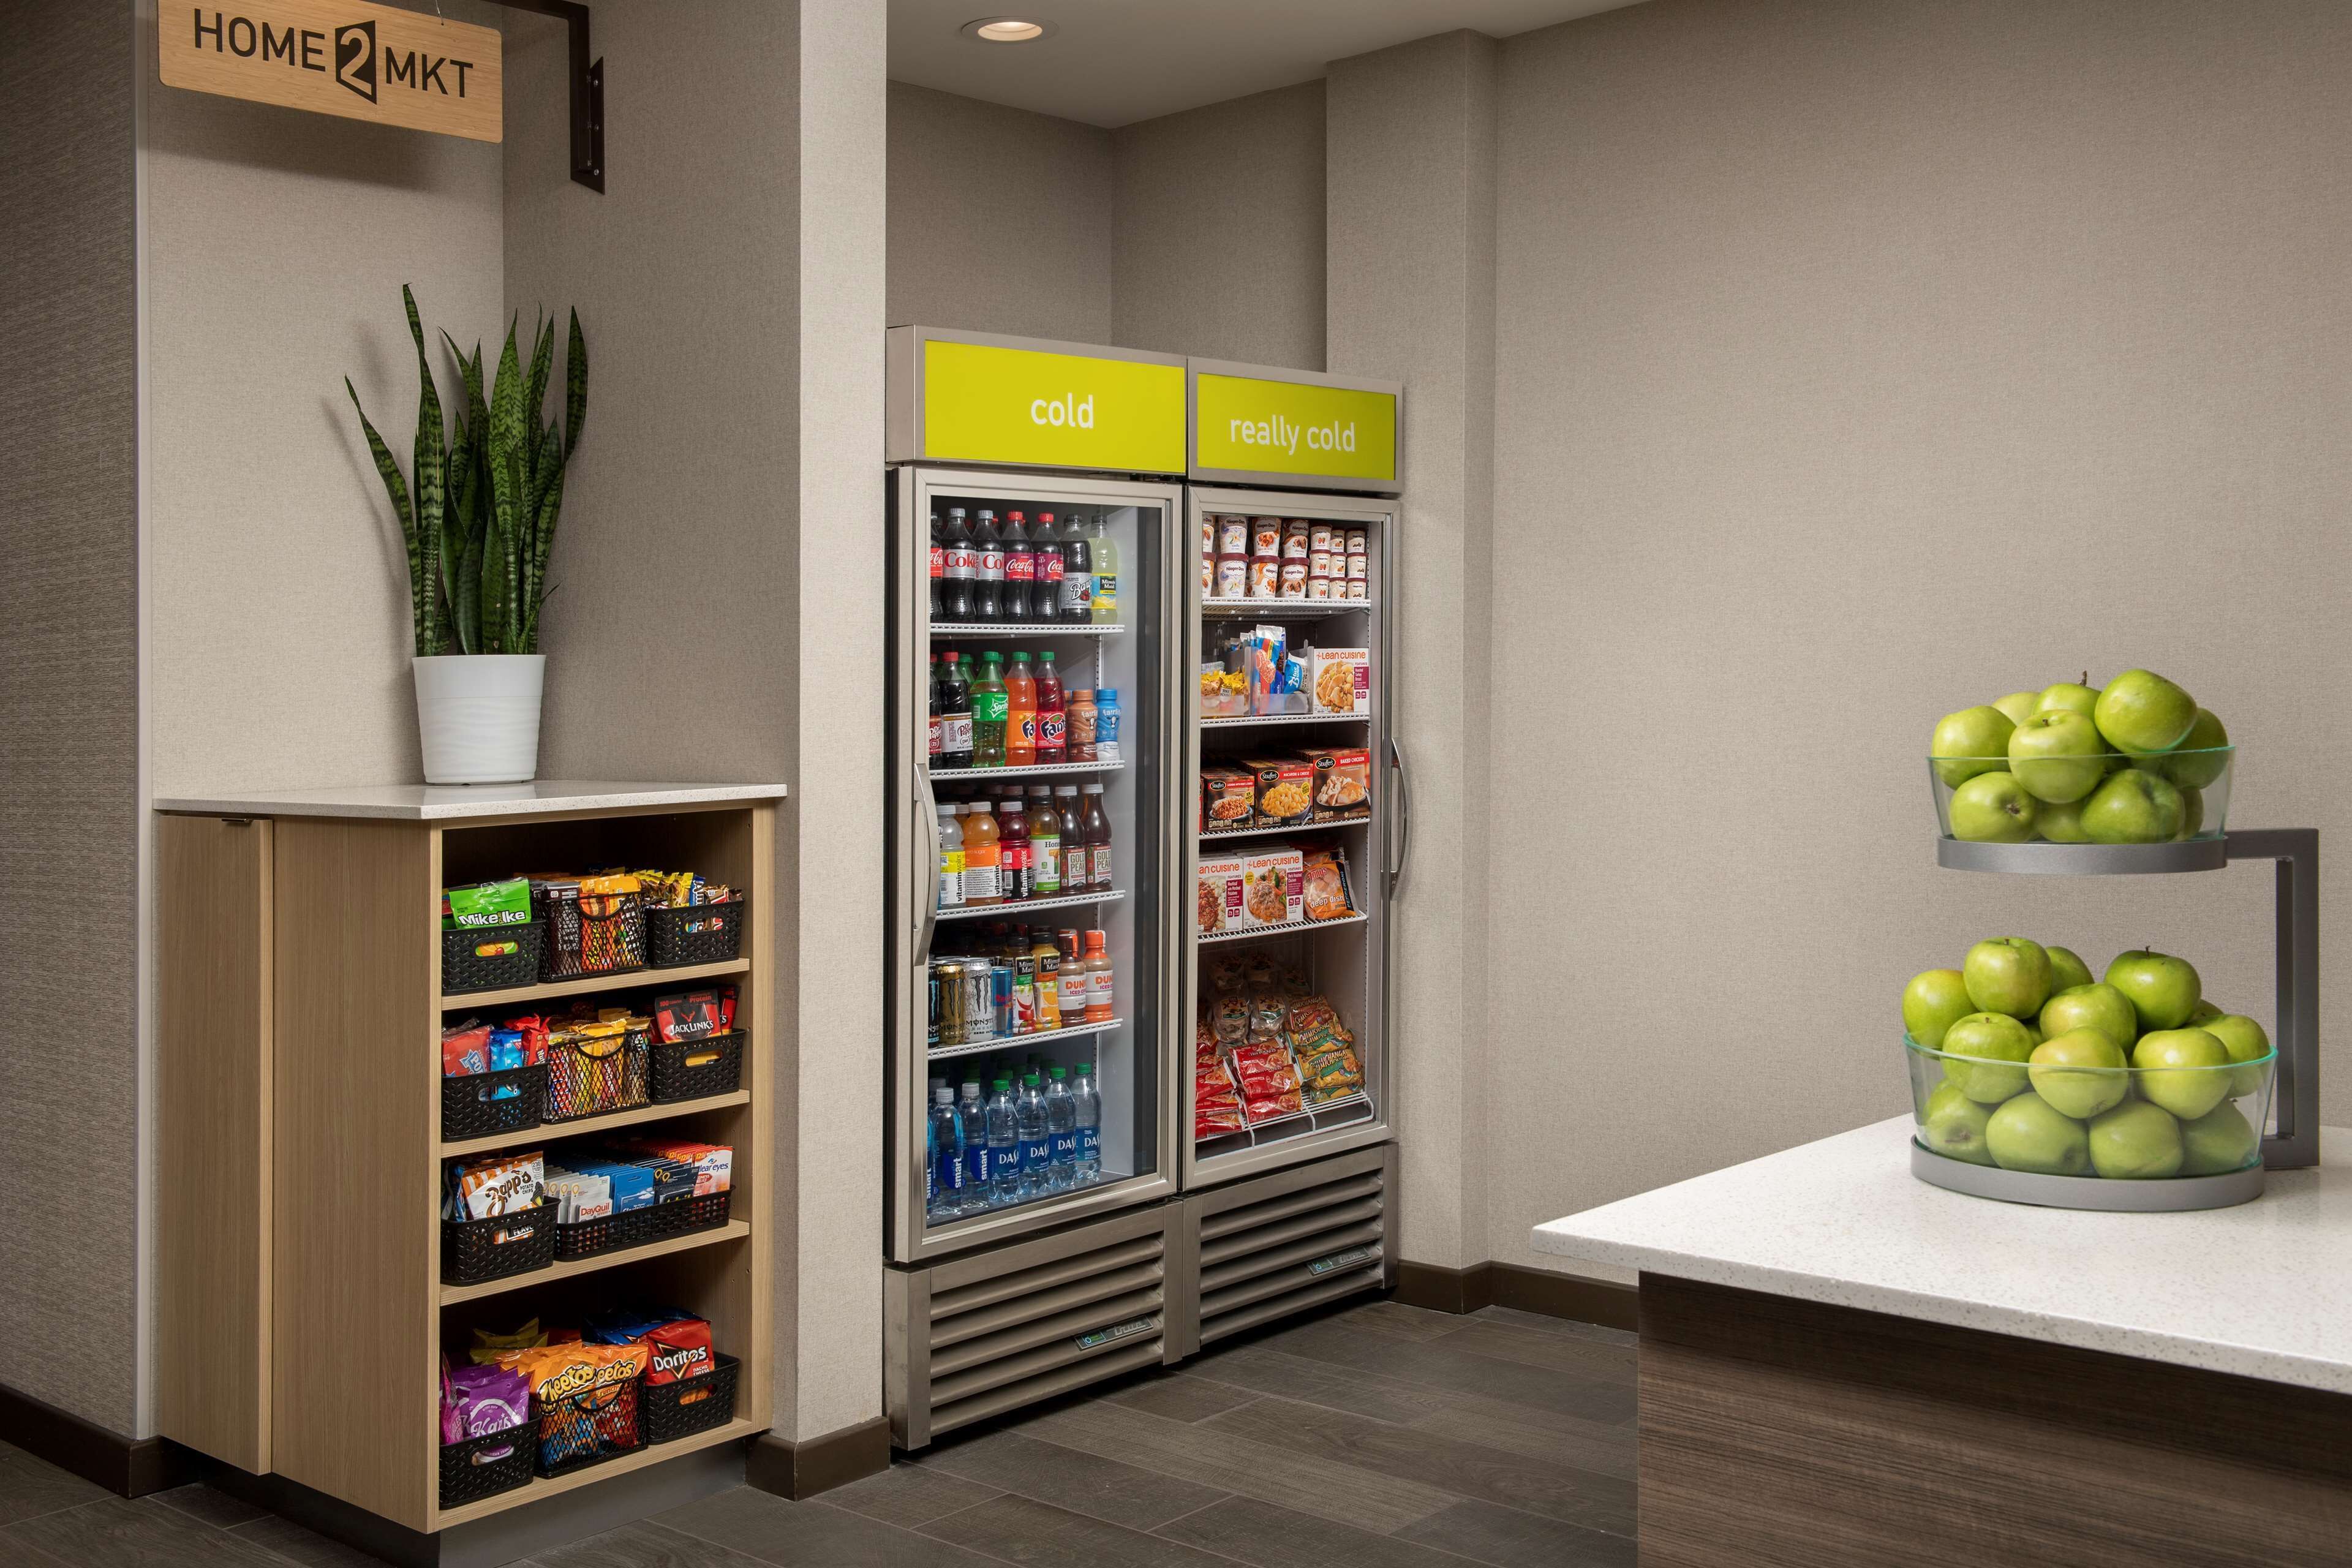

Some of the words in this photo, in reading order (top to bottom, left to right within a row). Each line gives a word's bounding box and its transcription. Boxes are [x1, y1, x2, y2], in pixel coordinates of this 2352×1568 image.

[1031, 393, 1095, 429] cold
[1230, 415, 1299, 456] really
[1307, 421, 1355, 452] cold
[1210, 864, 1240, 873] cuisine
[1253, 859, 1271, 868] Lean
[1272, 856, 1299, 865] cuisine
[1310, 897, 1328, 908] deep
[458, 913, 498, 925] Mike
[502, 910, 526, 923] Ike
[670, 1024, 690, 1036] JACK
[690, 1020, 714, 1031] LINK'S
[1085, 1133, 1101, 1147] DAS
[712, 1163, 729, 1172] eyes
[953, 1156, 962, 1189] smart
[484, 1170, 532, 1218] Zapp's
[580, 1202, 610, 1216] DayQuil
[653, 1346, 707, 1371] Doritos
